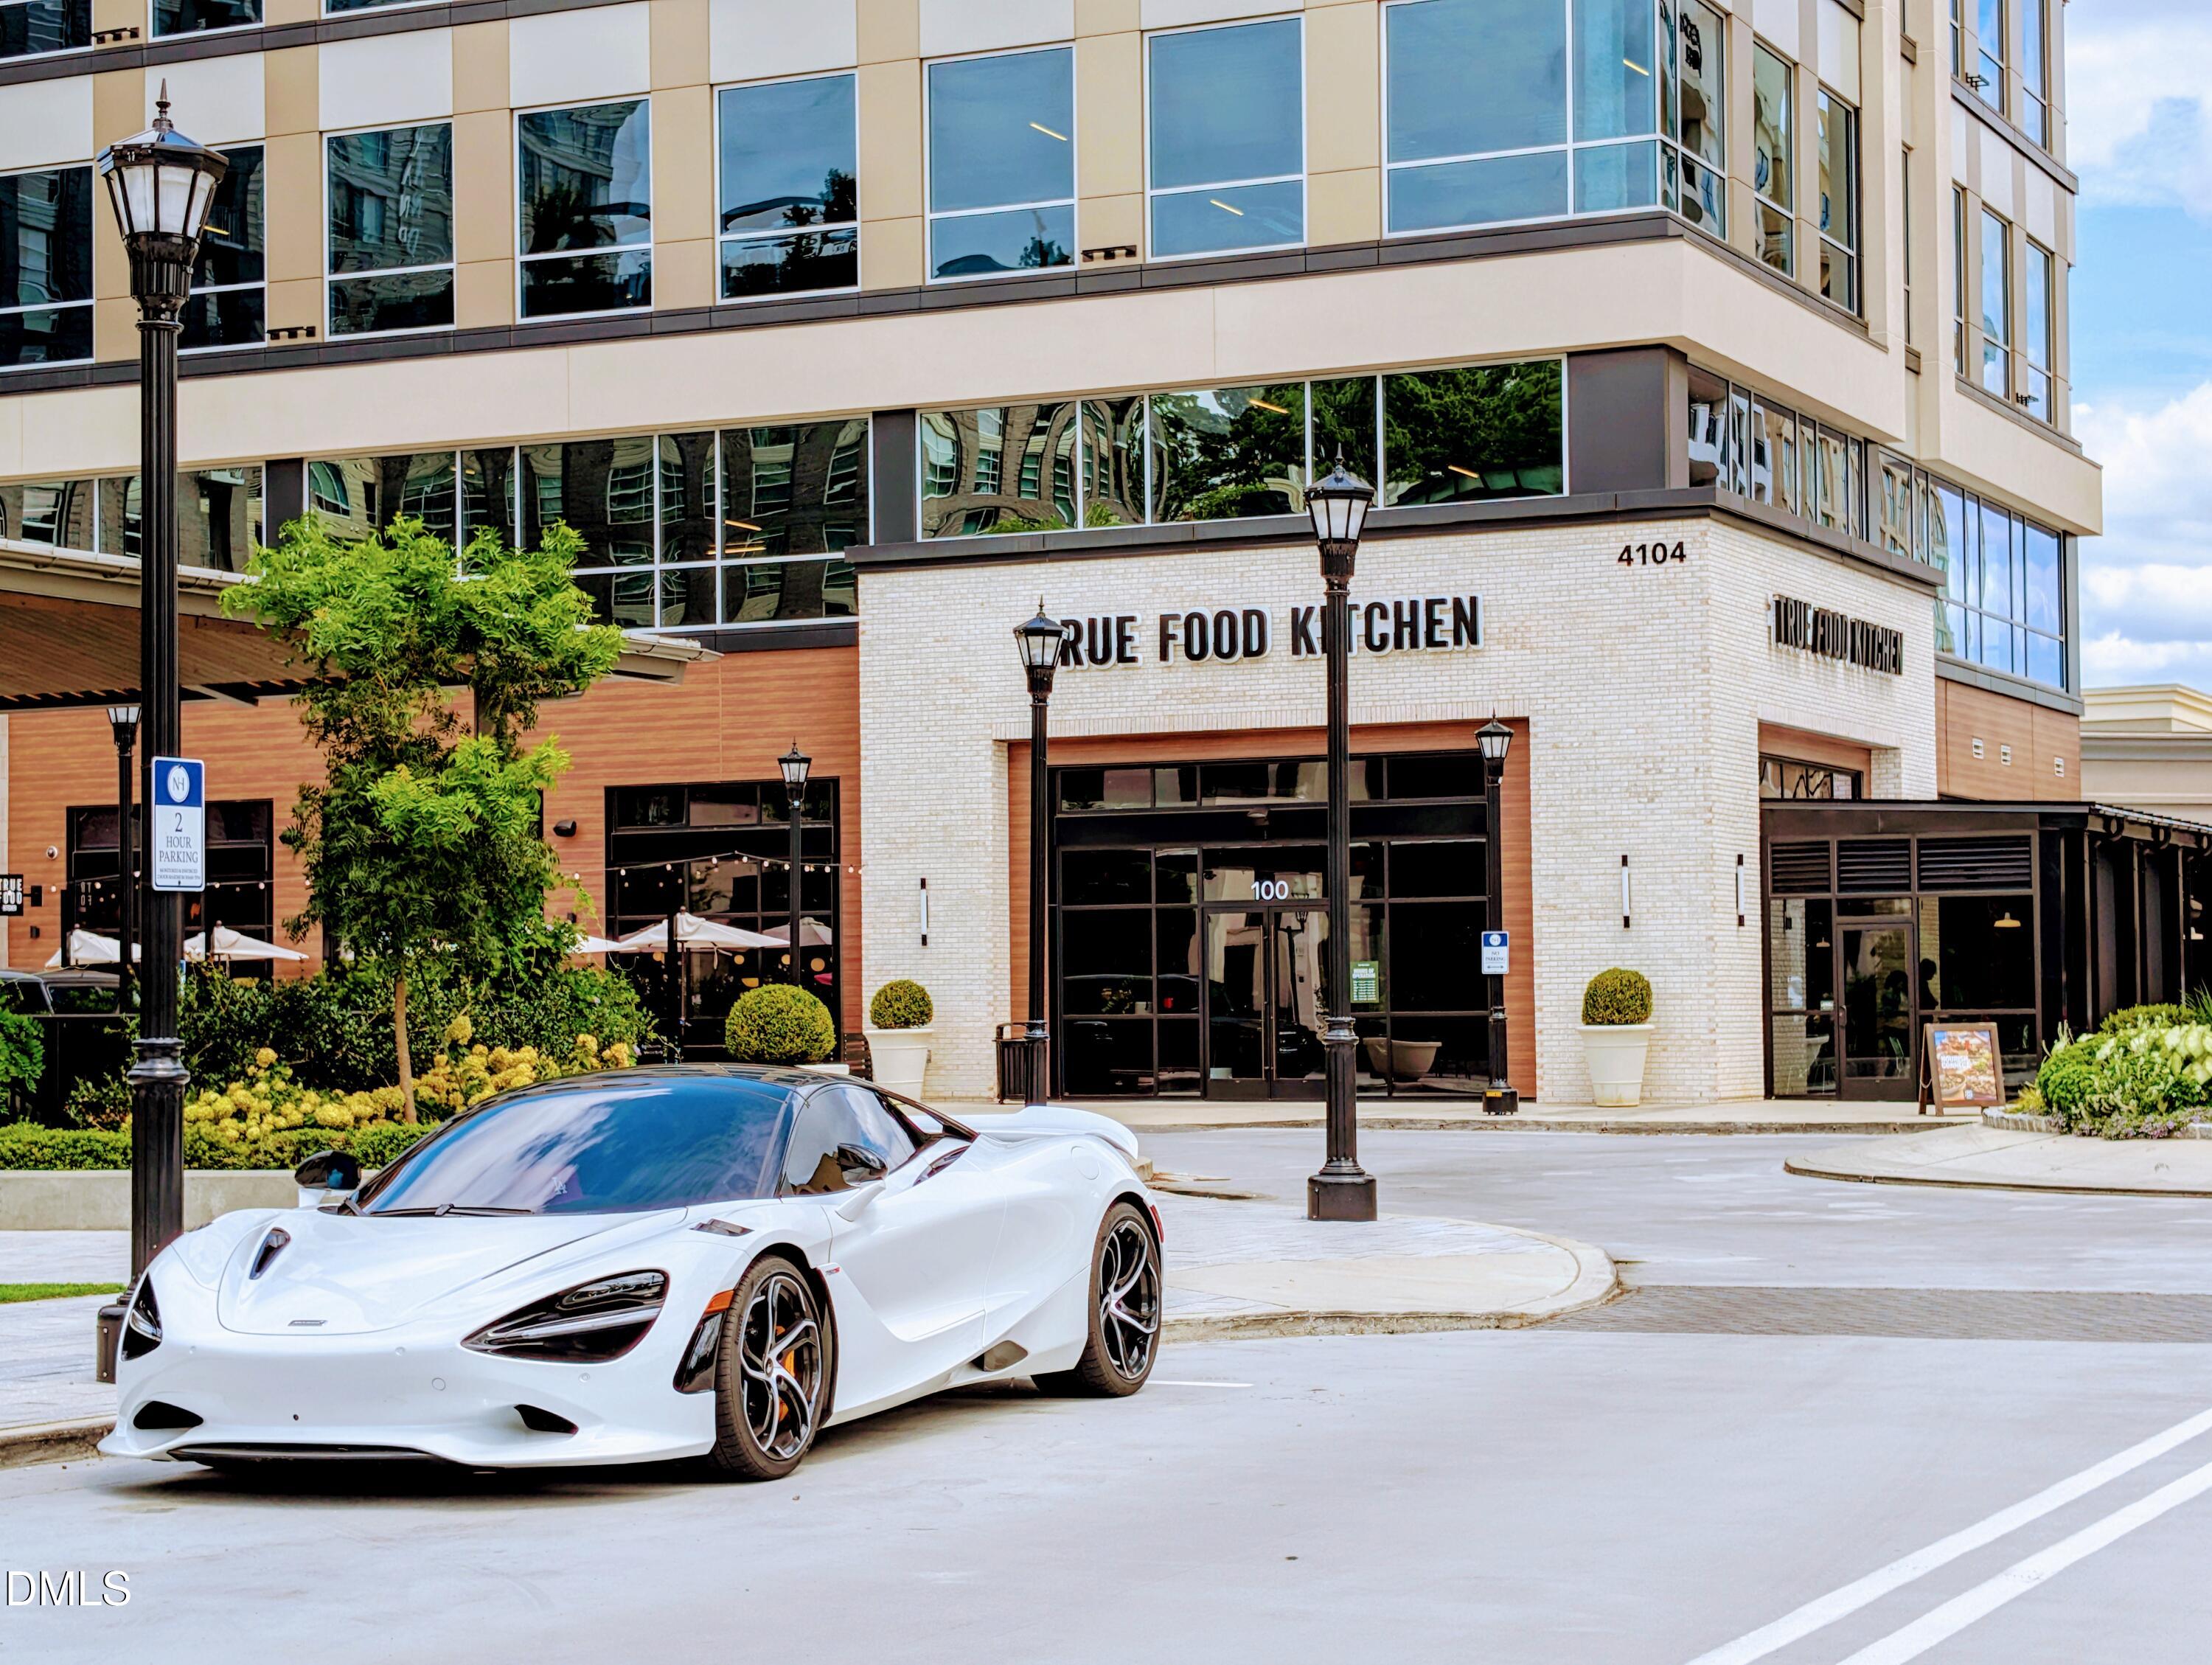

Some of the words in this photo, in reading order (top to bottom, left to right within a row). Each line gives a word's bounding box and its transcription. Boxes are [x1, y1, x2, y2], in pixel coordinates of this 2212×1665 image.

[1618, 541, 1686, 566] 4104
[1059, 616, 1139, 666] RUE
[1160, 609, 1267, 661] FOOD
[1773, 594, 1812, 650] TRUE
[1812, 608, 1848, 659] FOOD
[1851, 619, 1903, 675] KITCHEN
[175, 813, 183, 832] 2
[166, 835, 192, 849] HOUR
[159, 850, 198, 863] PARKING
[1251, 880, 1289, 900] 100
